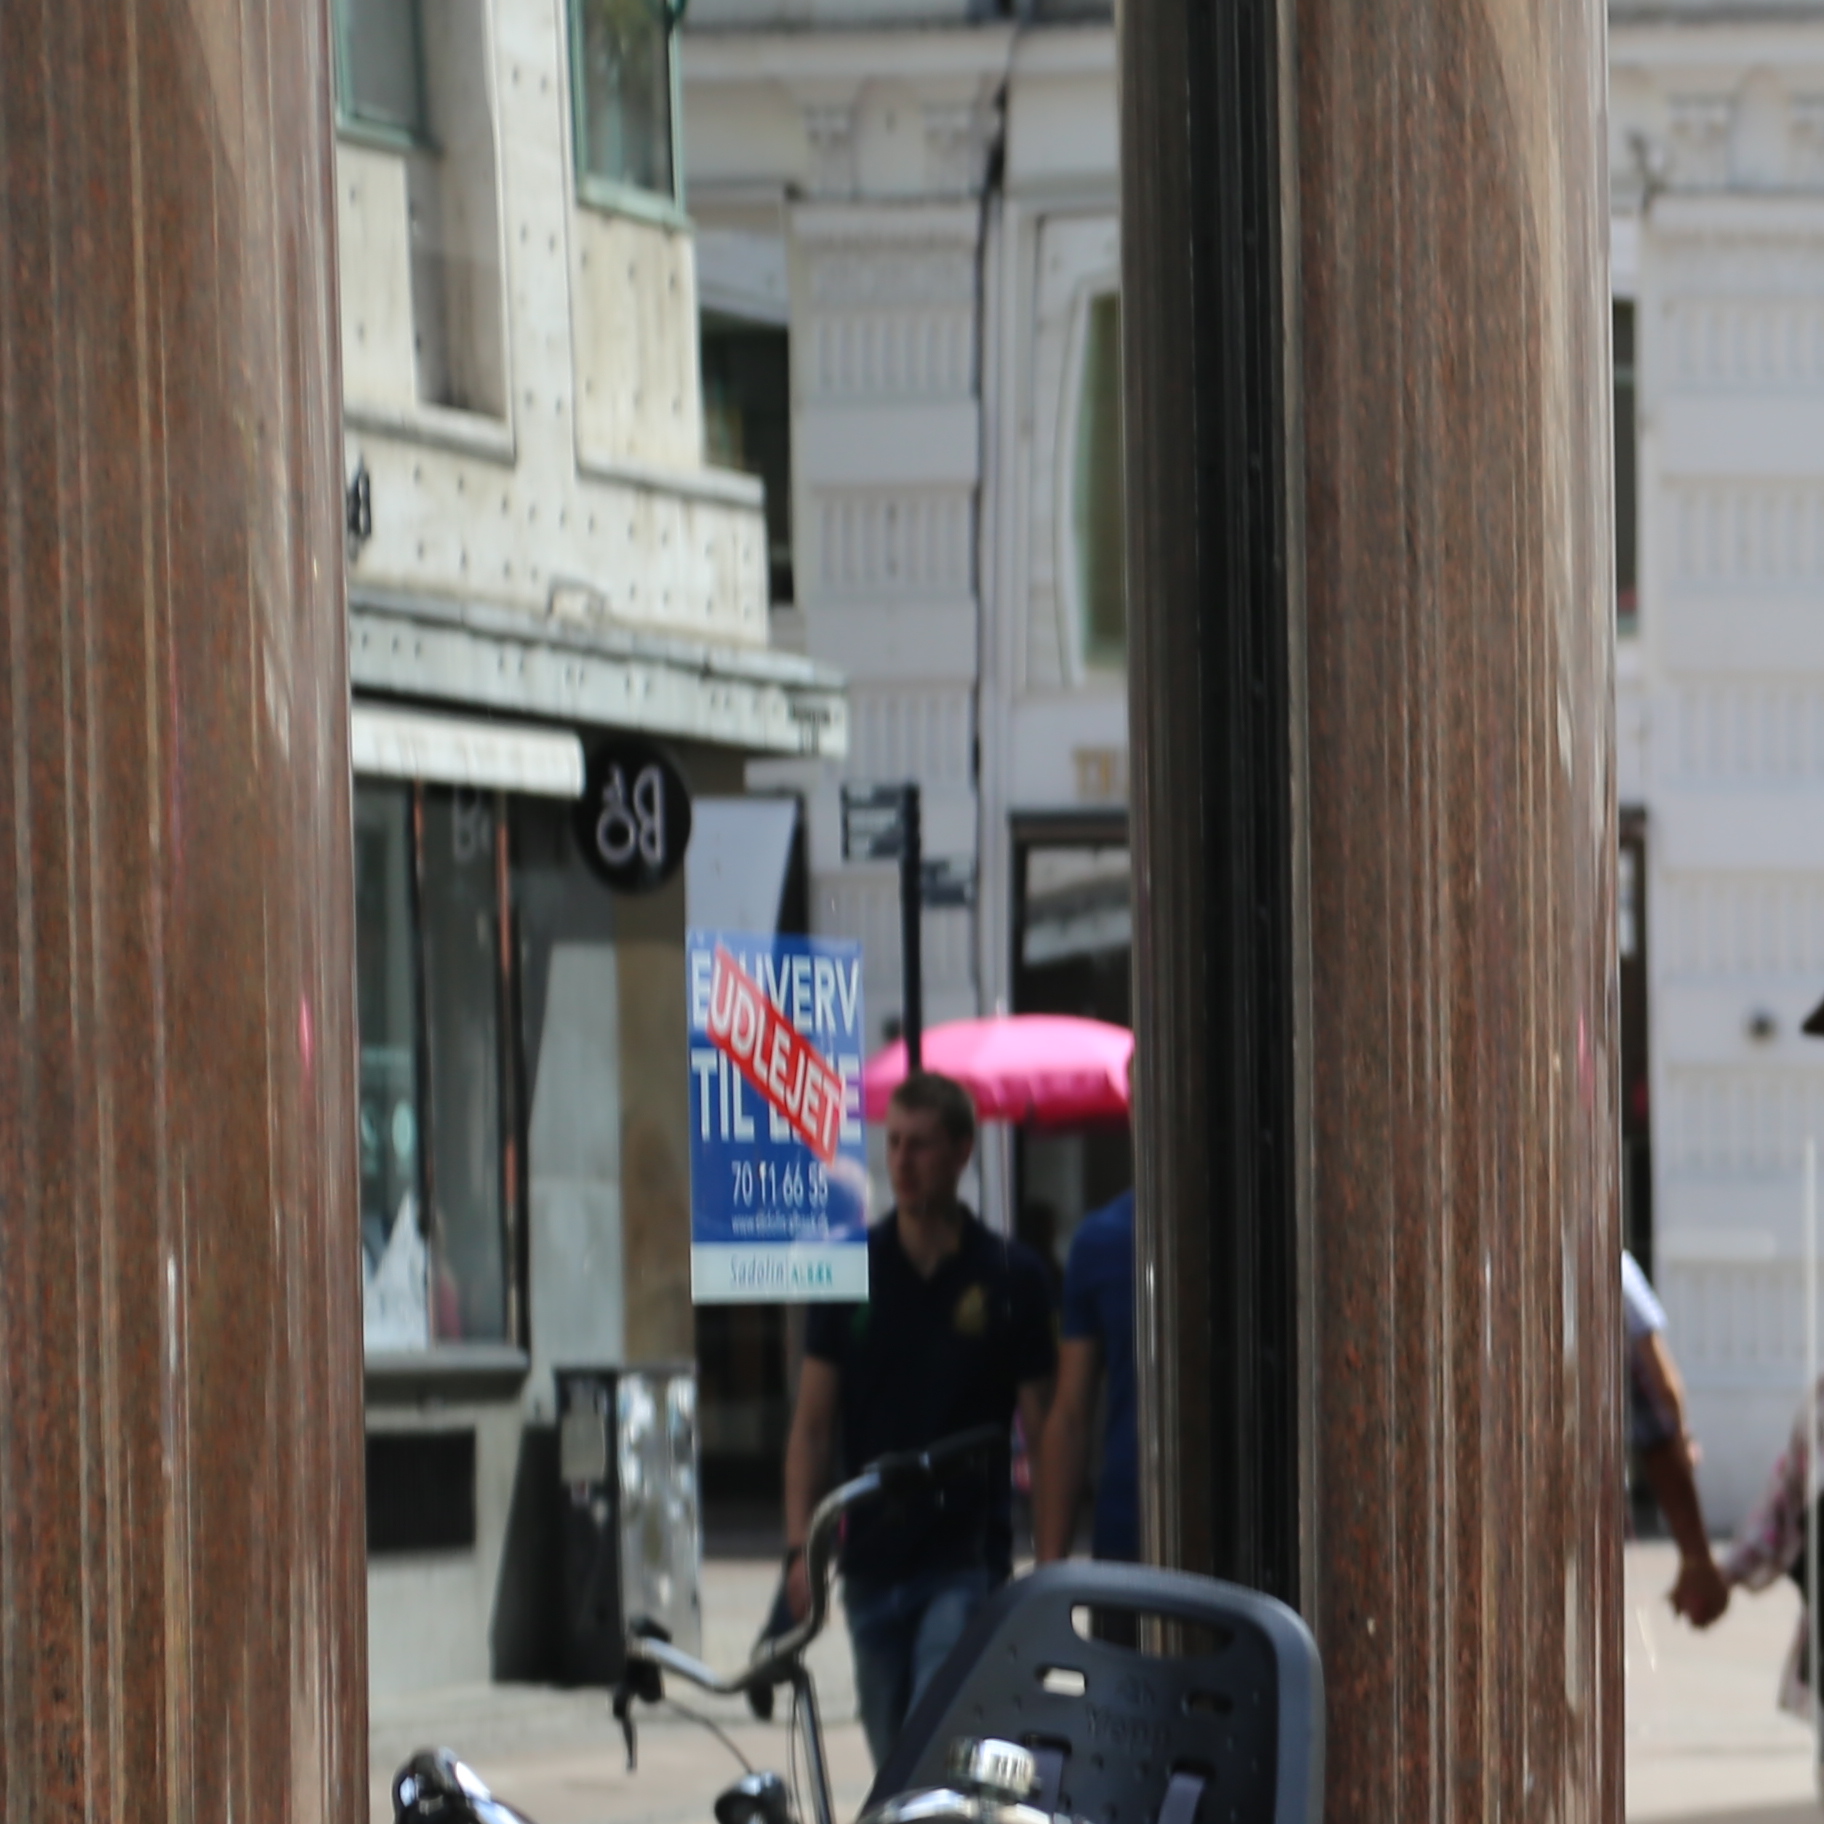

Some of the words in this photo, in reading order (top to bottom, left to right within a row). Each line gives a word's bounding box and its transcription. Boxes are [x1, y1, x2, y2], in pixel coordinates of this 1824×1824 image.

[709, 953, 843, 1155] UDLEJET
[731, 1159, 753, 1208] 70
[759, 1159, 776, 1207] 11
[783, 1160, 804, 1209] 66
[808, 1159, 828, 1209] 55
